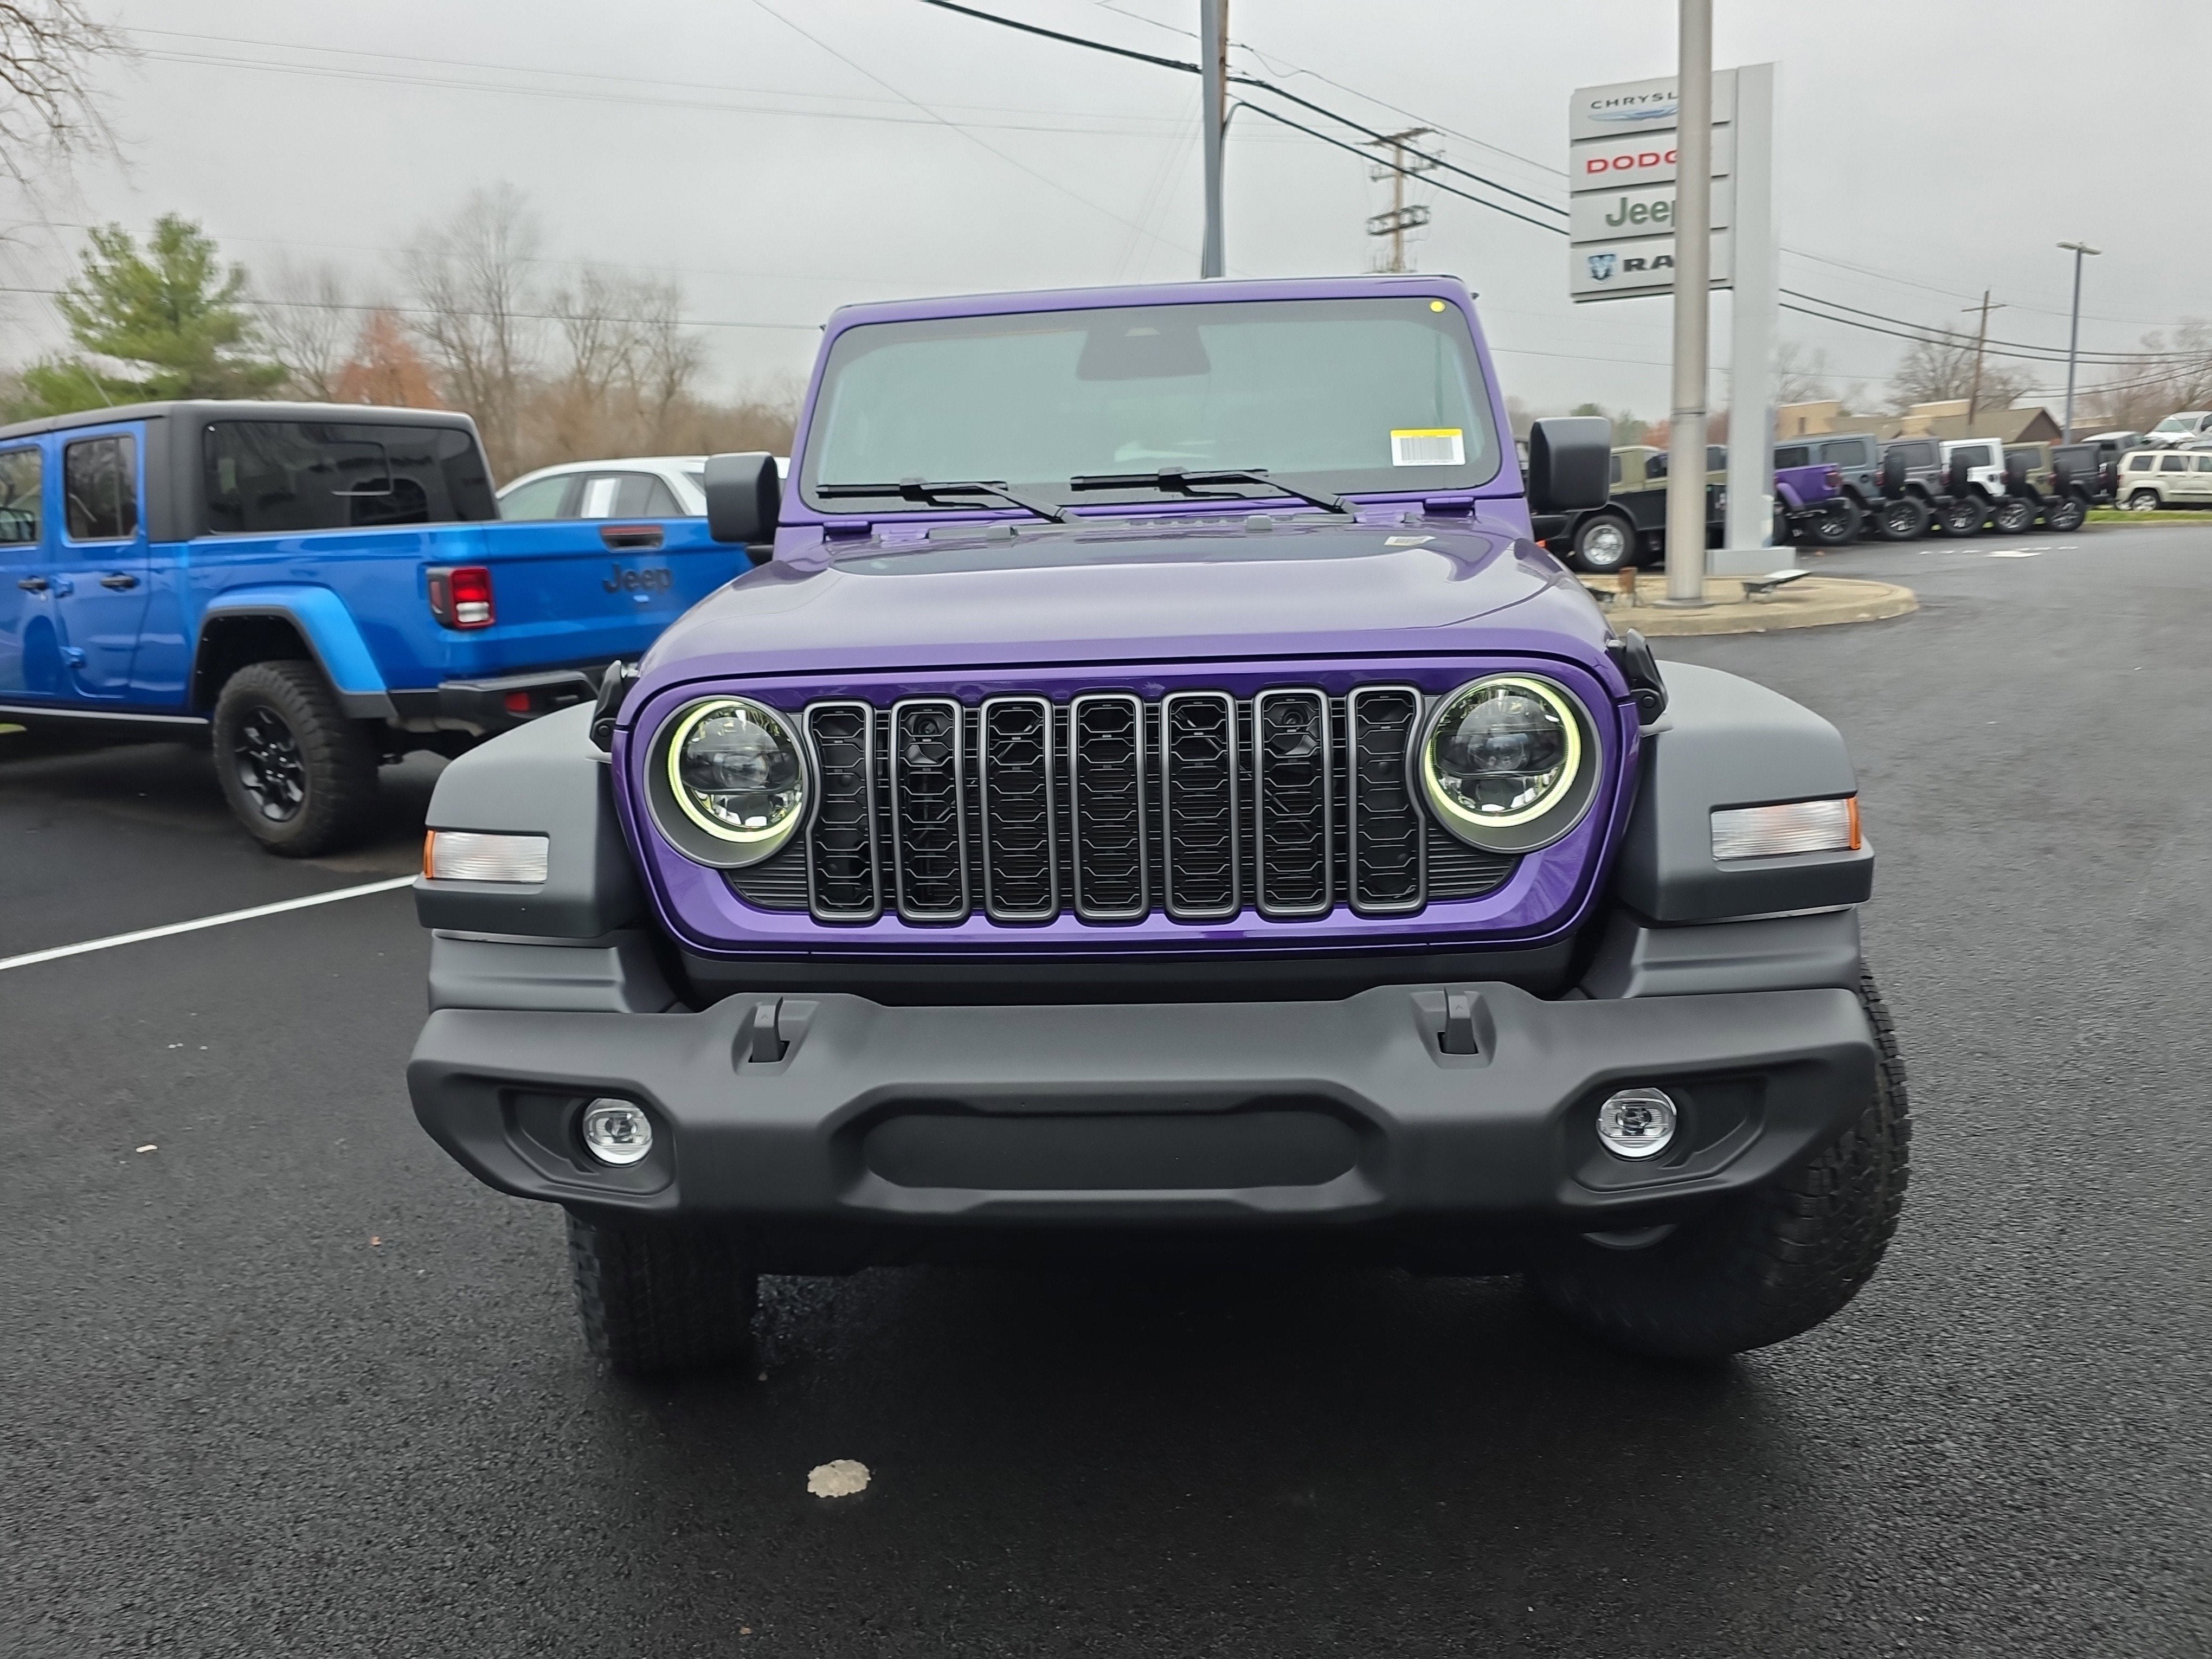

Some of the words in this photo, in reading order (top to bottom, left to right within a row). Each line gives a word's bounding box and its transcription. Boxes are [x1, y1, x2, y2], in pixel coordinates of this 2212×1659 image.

[1591, 92, 1678, 109] CHRYSL
[1587, 150, 1676, 173] DODG
[1606, 197, 1675, 227] Jee
[1623, 255, 1674, 272] RA
[602, 563, 671, 594] Jeep
